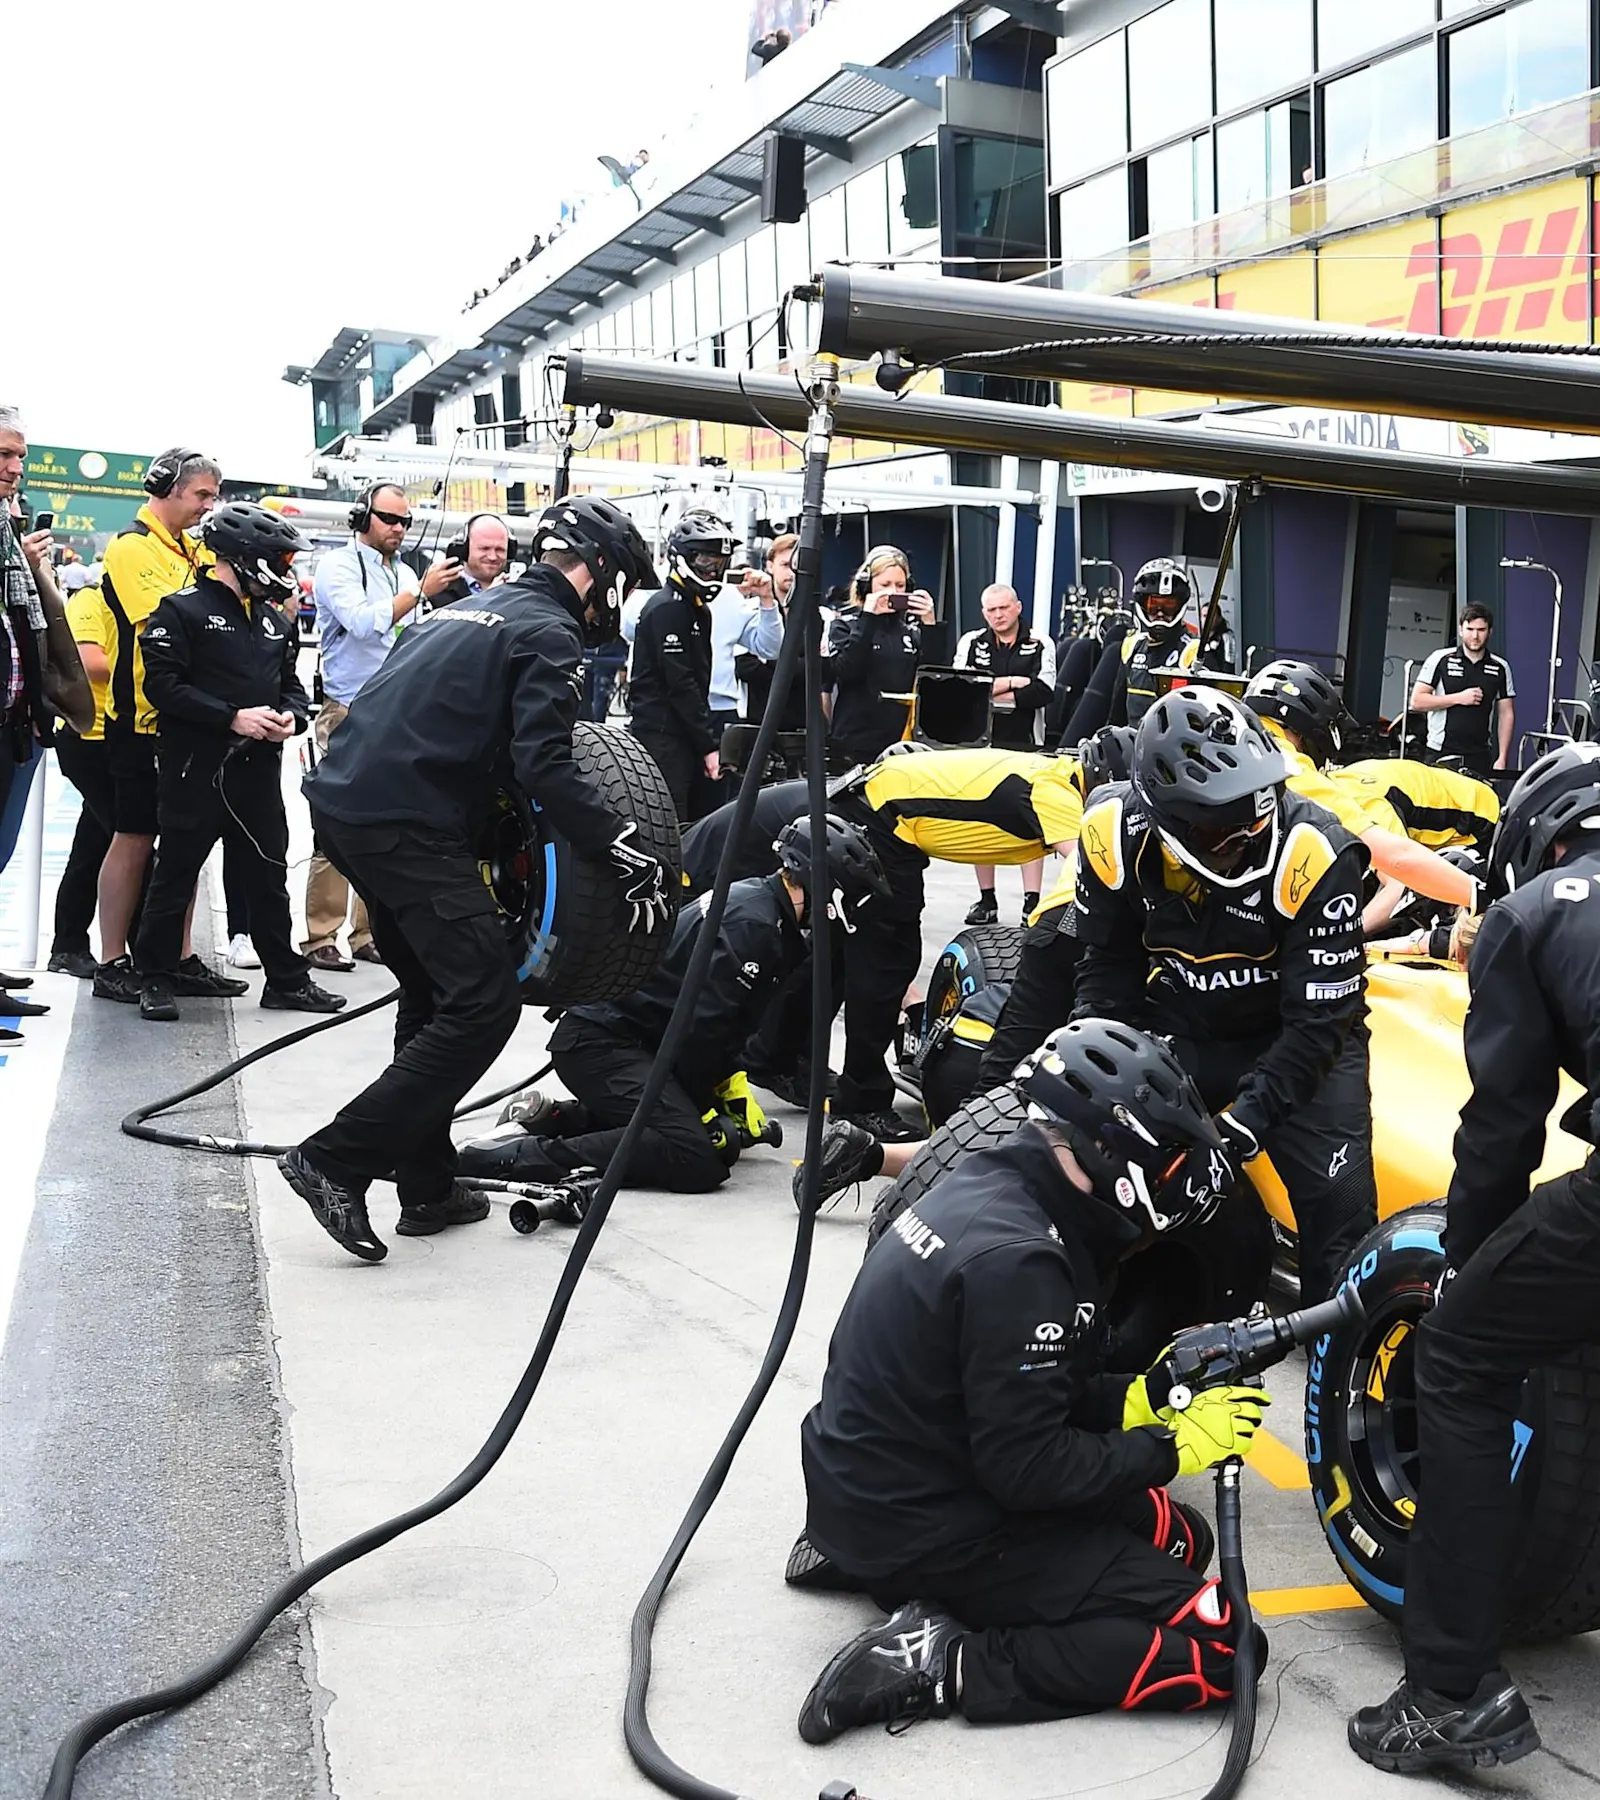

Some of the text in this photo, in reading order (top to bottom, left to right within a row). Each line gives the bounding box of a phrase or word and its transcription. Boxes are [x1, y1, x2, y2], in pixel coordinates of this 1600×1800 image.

[1338, 412, 1401, 450] INDIA
[27, 462, 68, 475] ROLEX
[1308, 946, 1360, 966] TOTAL
[1306, 974, 1361, 1000] PIRELLI
[1119, 1181, 1131, 1203] BELL
